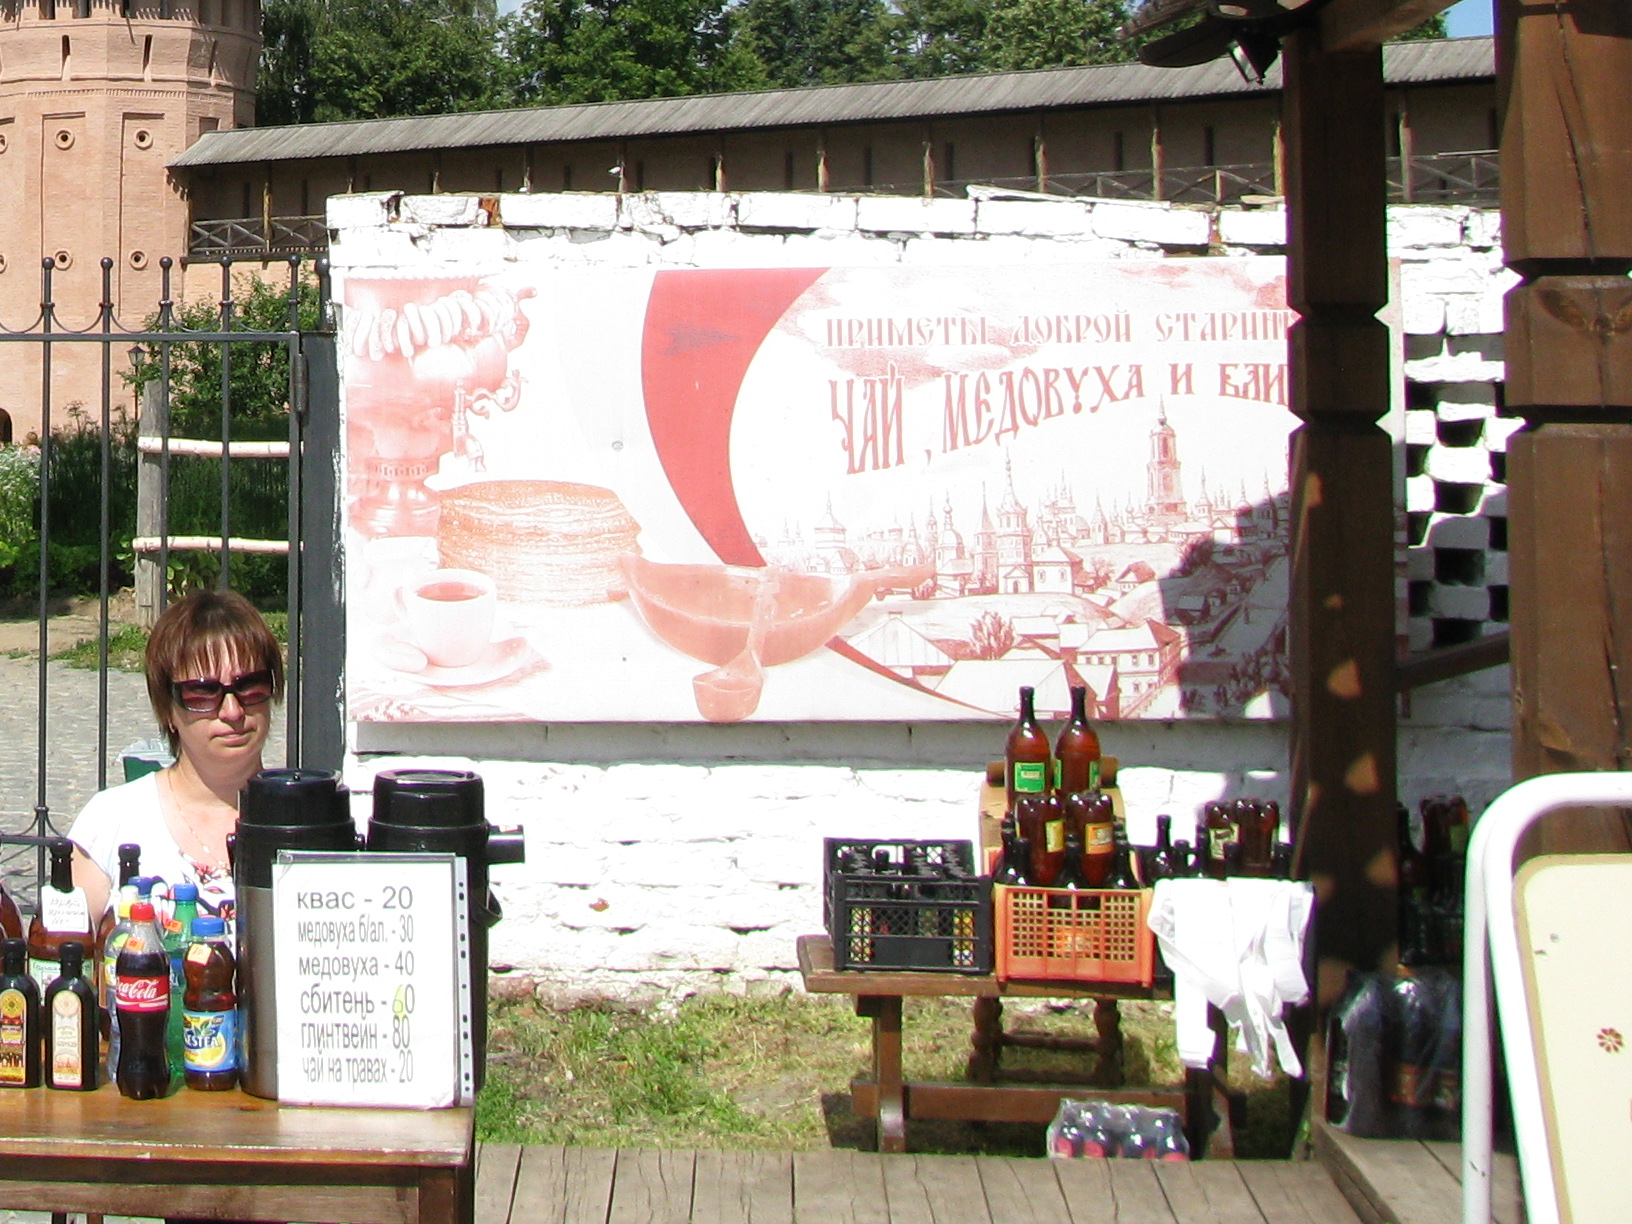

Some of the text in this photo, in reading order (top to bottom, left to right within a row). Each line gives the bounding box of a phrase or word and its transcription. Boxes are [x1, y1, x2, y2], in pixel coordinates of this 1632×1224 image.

[827, 317, 986, 346] ПРИМЕТЫ
[1012, 305, 1131, 345] ДОБРОЙ
[942, 363, 1146, 454] МЕДОВУХА
[1168, 362, 1194, 395] И
[1218, 362, 1289, 407] БЛИ
[297, 891, 355, 910] квас
[382, 885, 414, 910] 20
[297, 920, 356, 950] медовуха
[399, 914, 414, 943] 30
[298, 956, 379, 982] медовуха
[394, 950, 415, 976] 40
[117, 978, 160, 1000] ca-Cola
[300, 982, 375, 1014] сбитень
[392, 983, 416, 1014] 60
[392, 1014, 411, 1049] 80
[302, 1050, 324, 1084] чай
[328, 1057, 342, 1083] на
[345, 1057, 388, 1092] травах
[399, 1049, 414, 1084] 20
